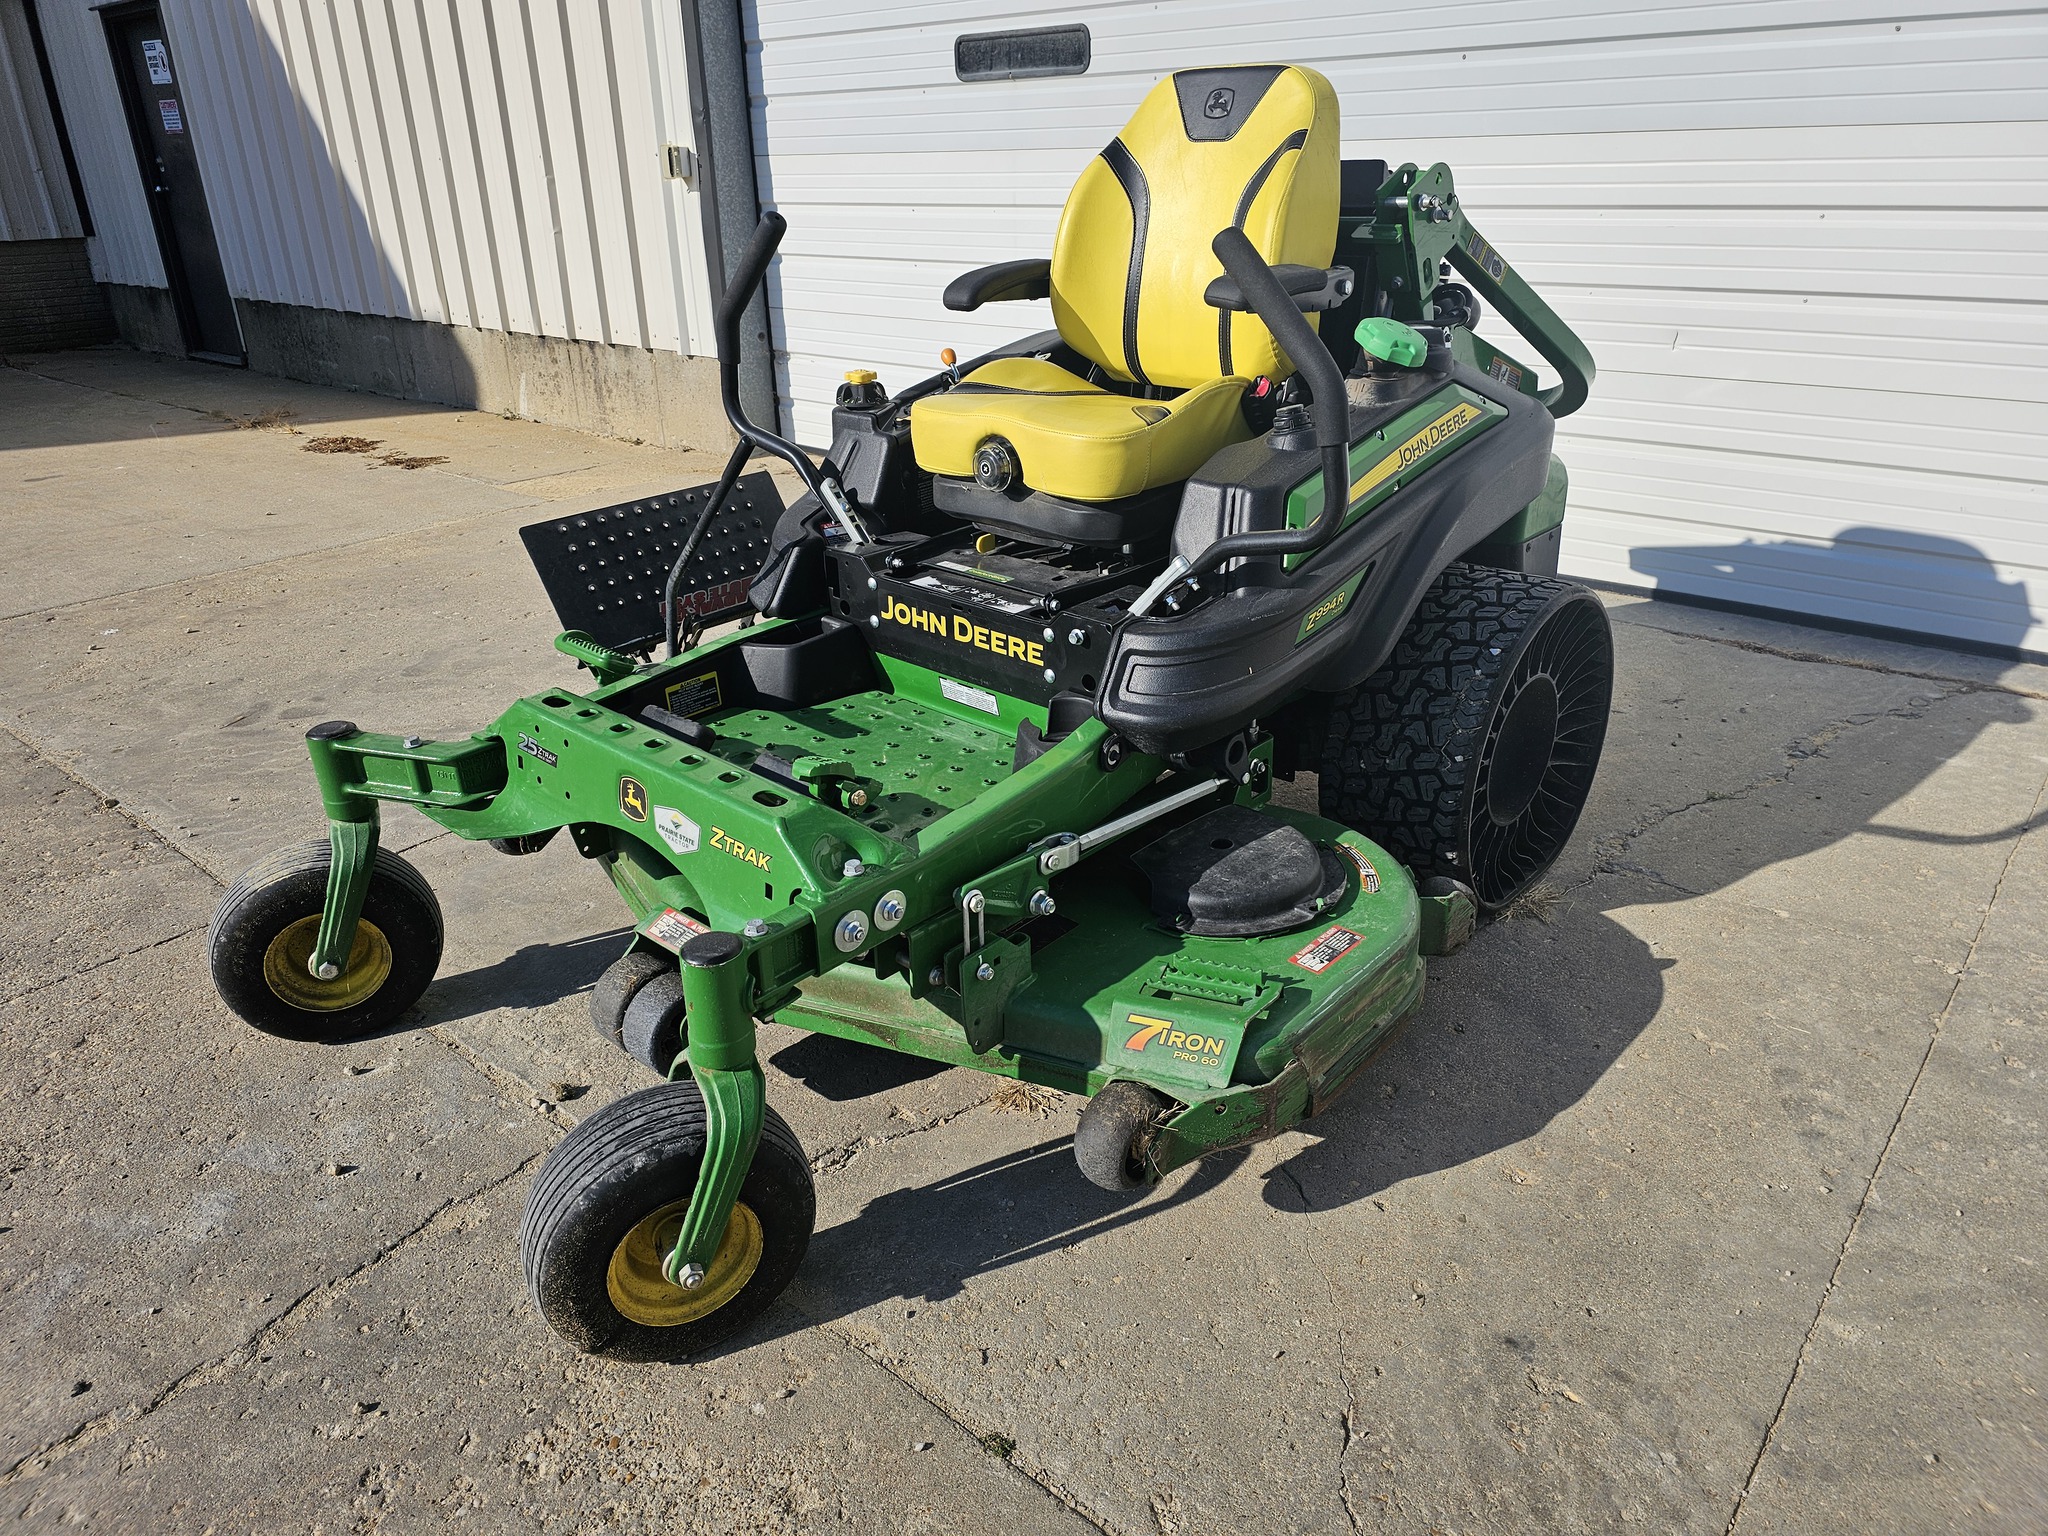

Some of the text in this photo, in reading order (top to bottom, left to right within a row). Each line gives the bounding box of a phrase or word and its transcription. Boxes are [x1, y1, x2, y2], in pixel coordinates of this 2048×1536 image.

[1397, 408, 1469, 470] JOHN DEERE
[1304, 591, 1346, 632] Z994R
[880, 595, 1045, 667] JOHN DEERE
[518, 731, 538, 756] 25
[658, 823, 695, 846] PRAIRIE STATE
[664, 833, 689, 849] TRACTOR
[709, 825, 773, 873] ZTRAK
[1172, 1050, 1219, 1067] PRO 60
